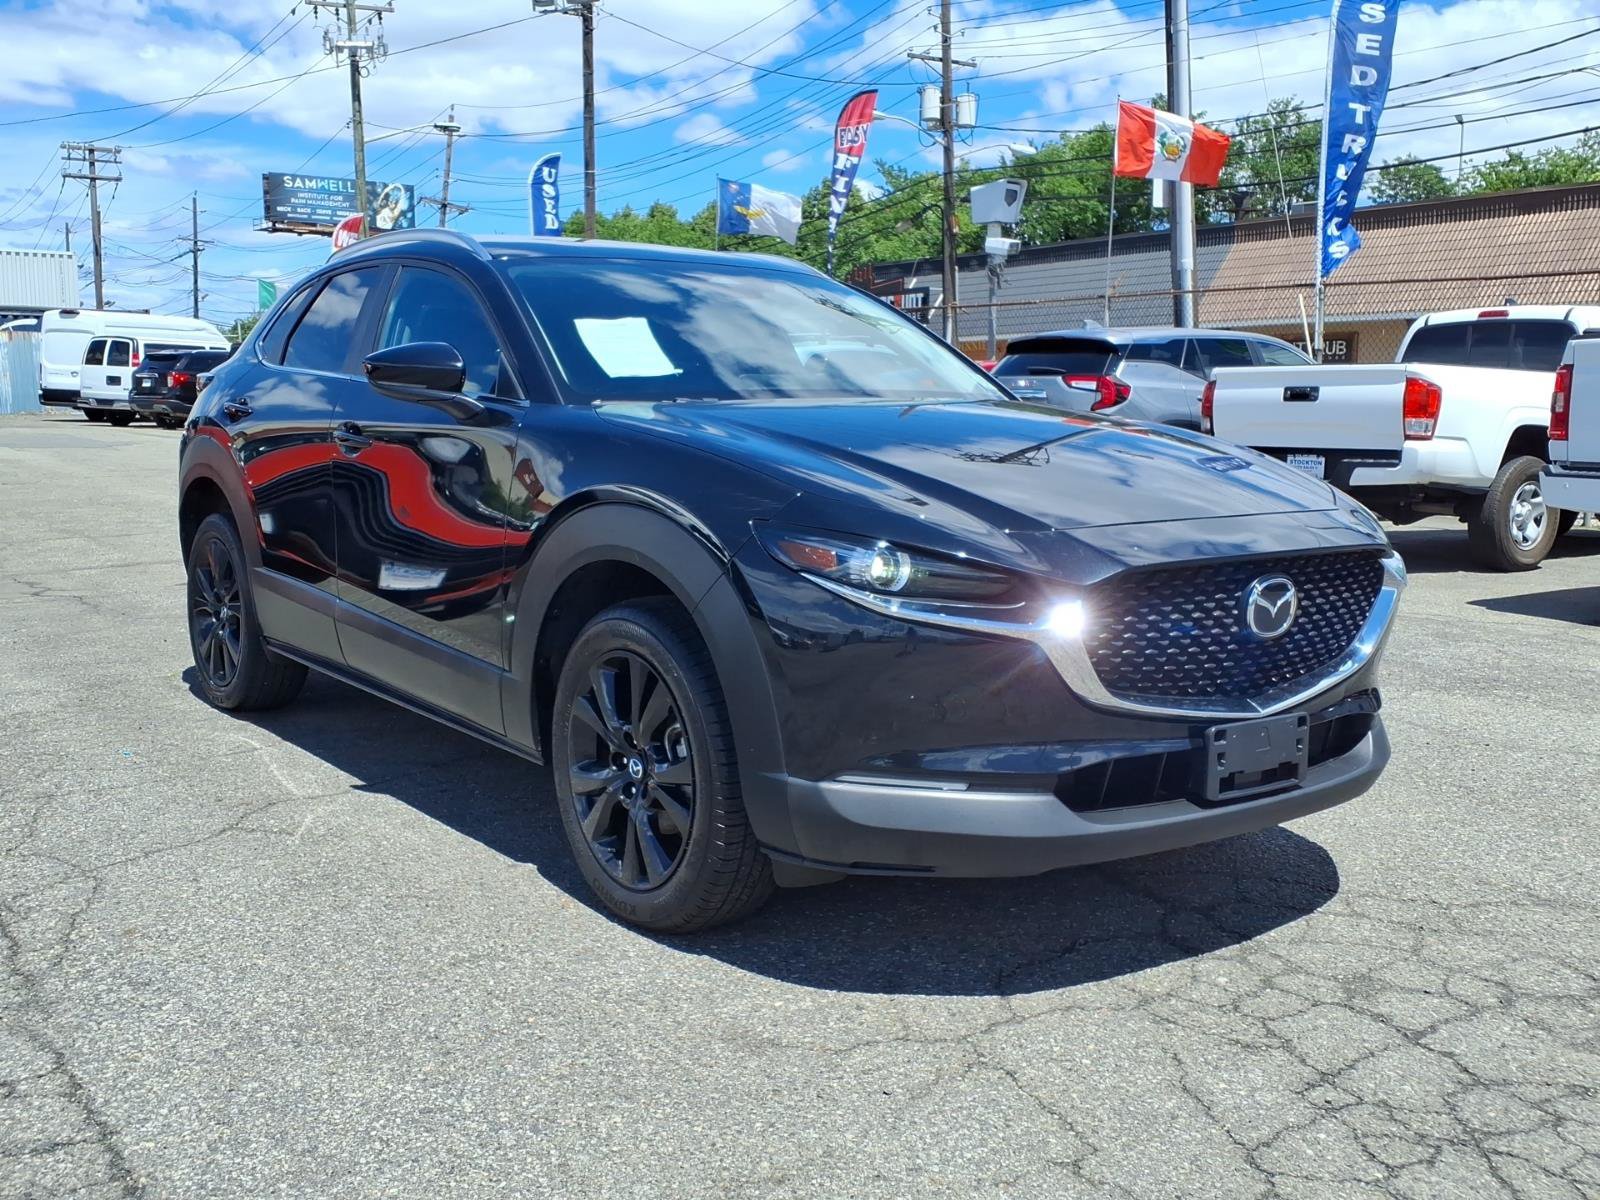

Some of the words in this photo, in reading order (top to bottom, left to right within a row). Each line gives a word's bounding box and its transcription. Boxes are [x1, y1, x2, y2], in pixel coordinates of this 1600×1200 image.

[1350, 3, 1386, 86] SED
[838, 123, 870, 148] EASY
[283, 176, 355, 192] SAMWELL
[297, 192, 329, 200] INSTITUTE
[307, 199, 350, 208] MANAGEMENT
[542, 167, 559, 229] USED
